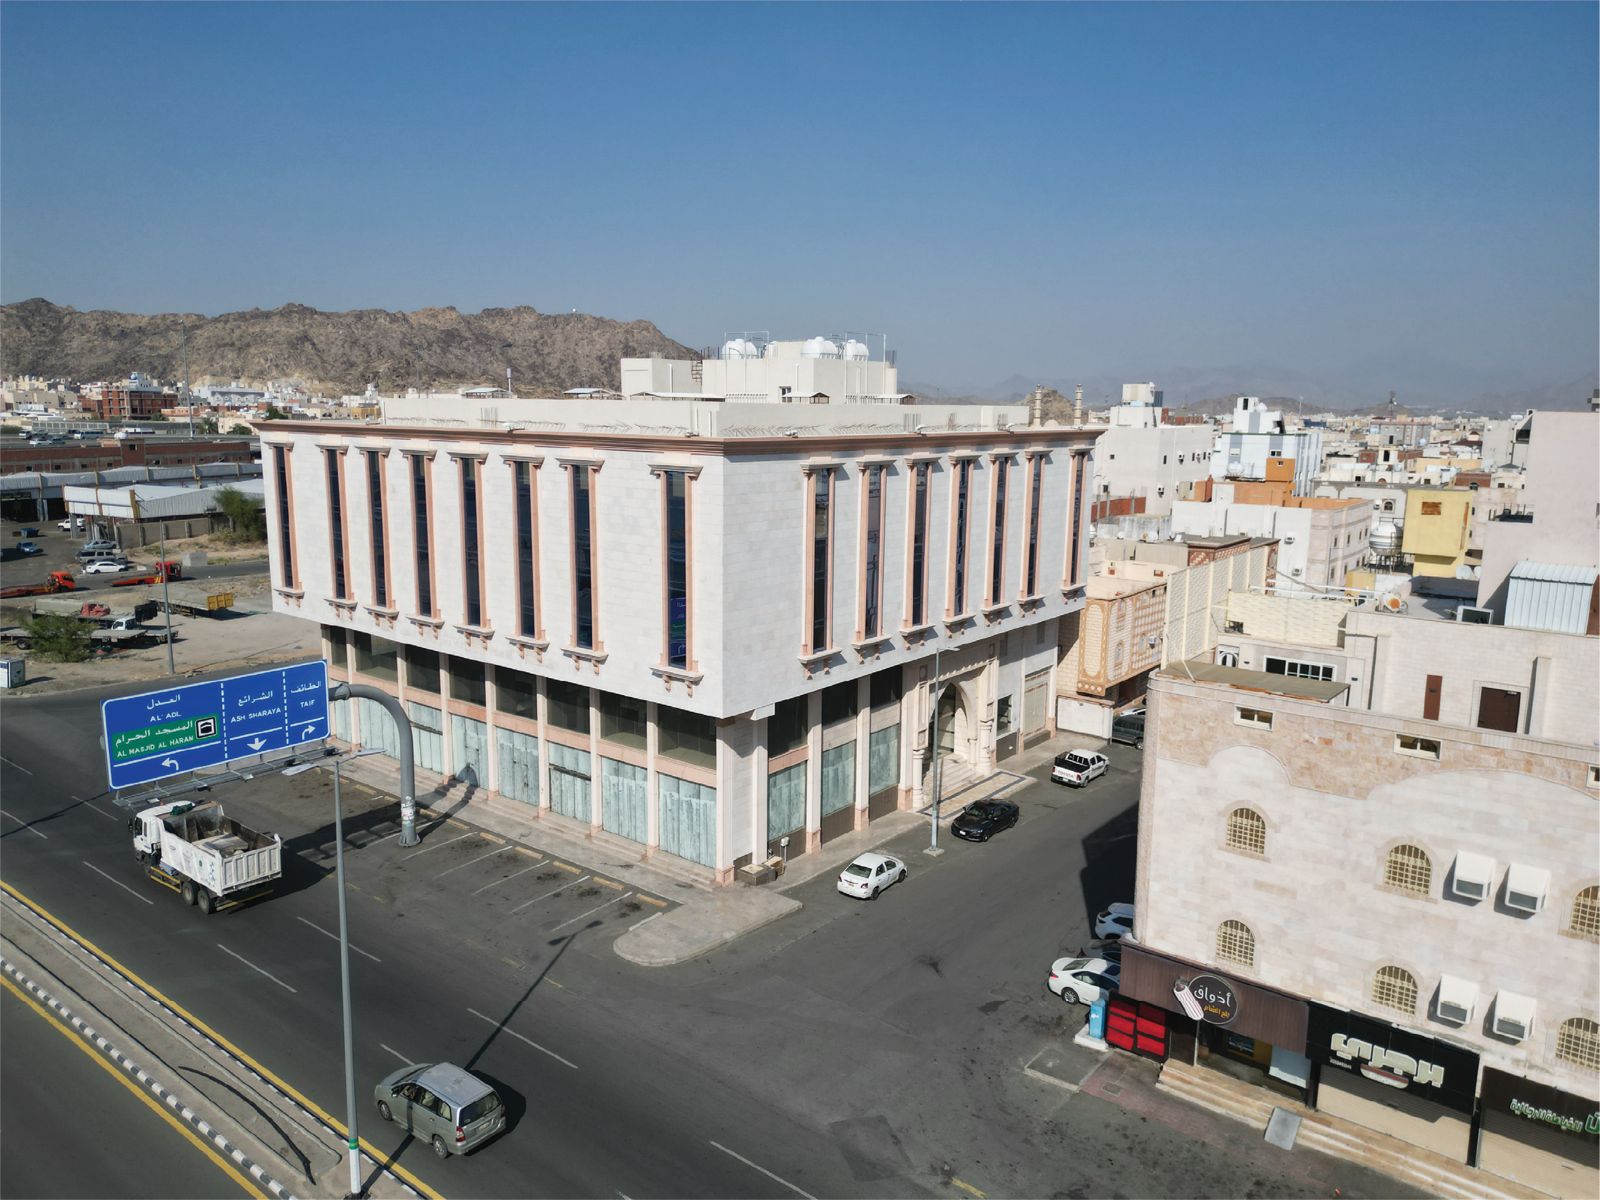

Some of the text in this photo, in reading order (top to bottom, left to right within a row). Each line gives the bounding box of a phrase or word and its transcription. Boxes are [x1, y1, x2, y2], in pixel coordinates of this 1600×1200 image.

[290, 681, 321, 693] الطائف
[147, 694, 180, 710] العدل
[238, 690, 273, 706] الشرائع
[300, 699, 315, 708] TAIF
[165, 711, 182, 720] ADL
[230, 707, 281, 723] ASH SHARAYA
[115, 720, 193, 748] المسجد الحرام
[117, 750, 127, 758] AL
[129, 744, 155, 755] MASJID
[1193, 984, 1231, 1008] أذواق
